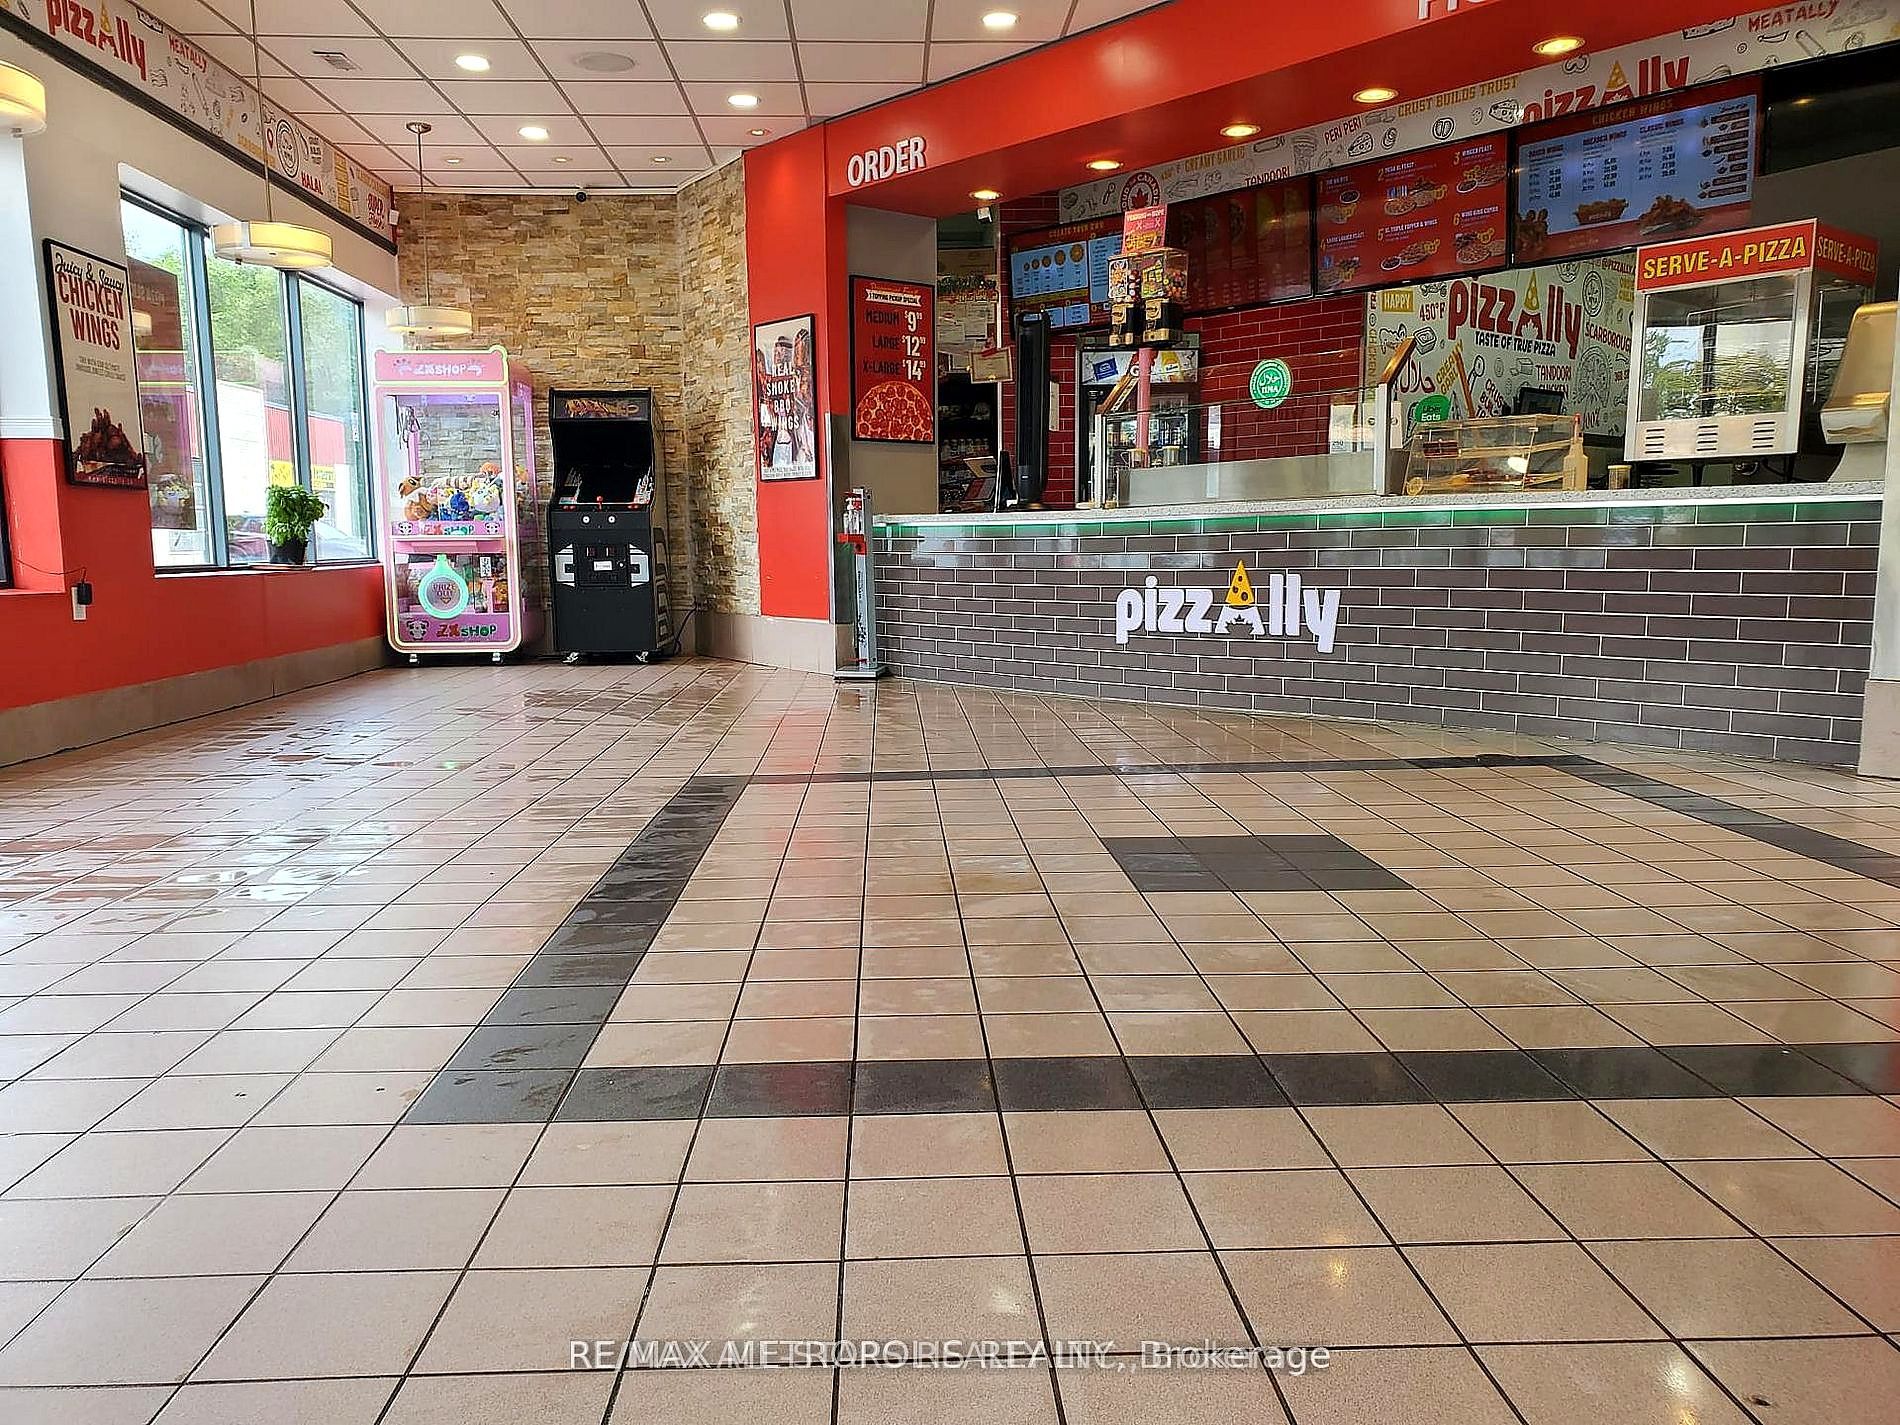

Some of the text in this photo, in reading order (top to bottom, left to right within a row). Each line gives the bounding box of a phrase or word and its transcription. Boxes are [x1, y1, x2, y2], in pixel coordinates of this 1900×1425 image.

[1397, 75, 1518, 117] CRUST BUILDS TRUST
[1324, 116, 1362, 144] PERI PERI
[847, 136, 927, 187] ORDER
[1244, 166, 1291, 187] TANDOORI
[1643, 236, 1806, 280] SERVE-A-PIZZA
[1817, 235, 1876, 271] SERVE-A-PIZZA
[55, 252, 125, 291] Juicy & Saucy
[57, 272, 125, 321] CHICKEN
[1384, 293, 1411, 310] HAPPY
[864, 309, 900, 325] MEDIUM
[1419, 302, 1446, 321] 450°F
[1448, 269, 1582, 360] pizzAlly
[70, 308, 120, 350] WINGS
[1475, 331, 1556, 357] TASTE OF TRUE PIZZA
[772, 363, 795, 377] REAL
[1536, 364, 1572, 382] TANDOORI
[766, 377, 801, 397] SMOKEY
[774, 400, 791, 414] BBQ
[1421, 413, 1441, 422] Eats
[1422, 405, 1441, 414] Uber
[771, 415, 800, 432] WINGS
[433, 582, 456, 591] PRIZE
[1116, 559, 1341, 653] pizzAlly
